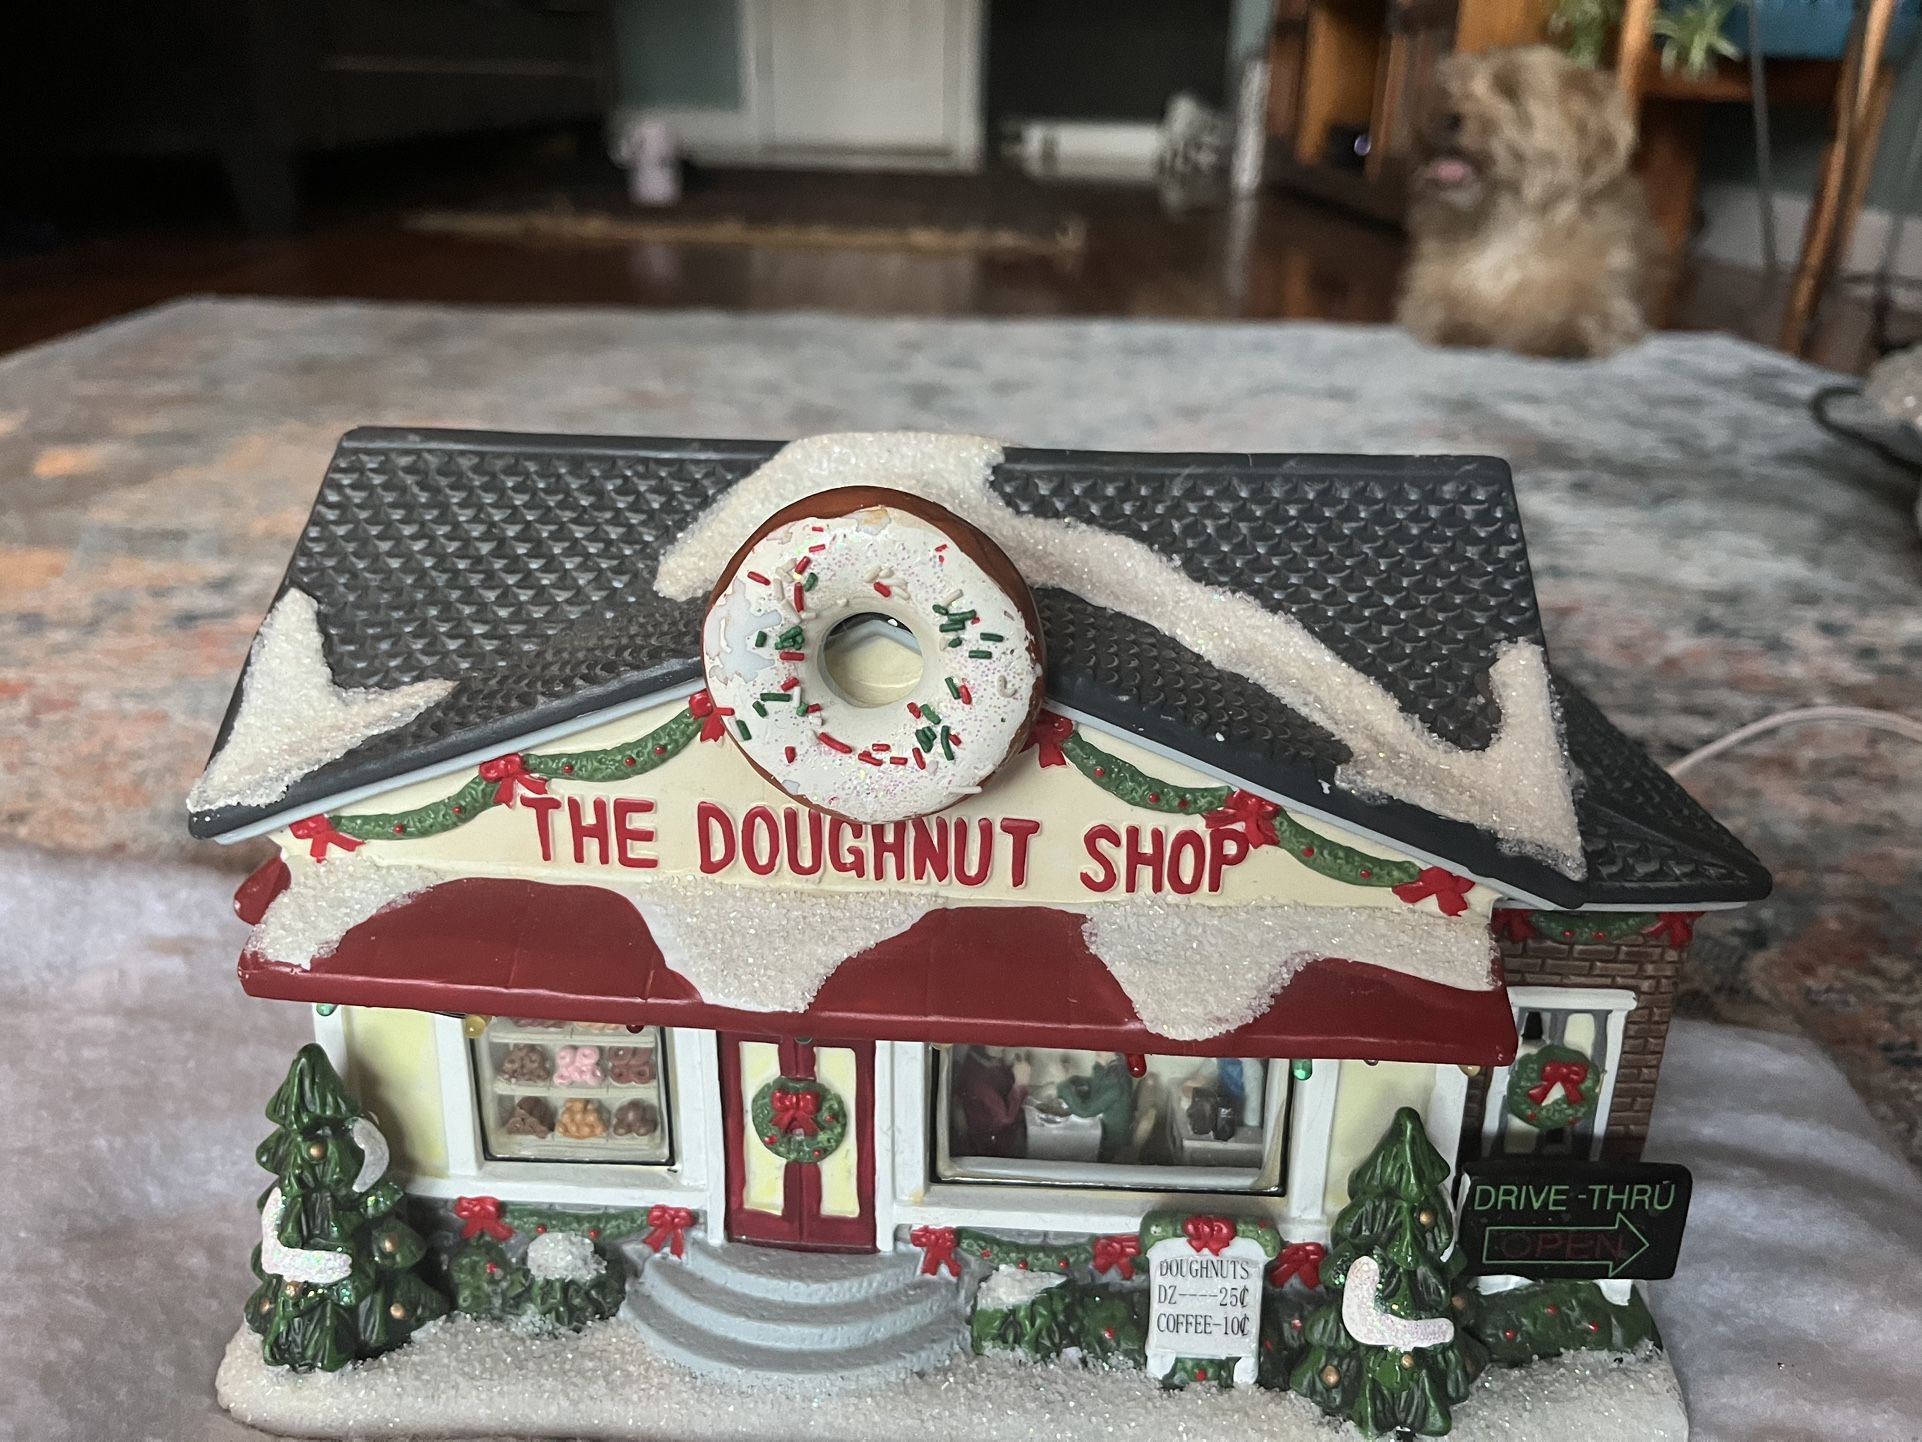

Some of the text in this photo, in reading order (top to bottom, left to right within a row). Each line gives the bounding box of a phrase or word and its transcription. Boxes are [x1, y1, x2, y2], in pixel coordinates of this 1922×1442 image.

[520, 796, 1250, 895] THE DOUGHNUT SHOP
[1500, 1232, 1624, 1260] OPEN
[1160, 1258, 1250, 1280] DOUGHNUTS
